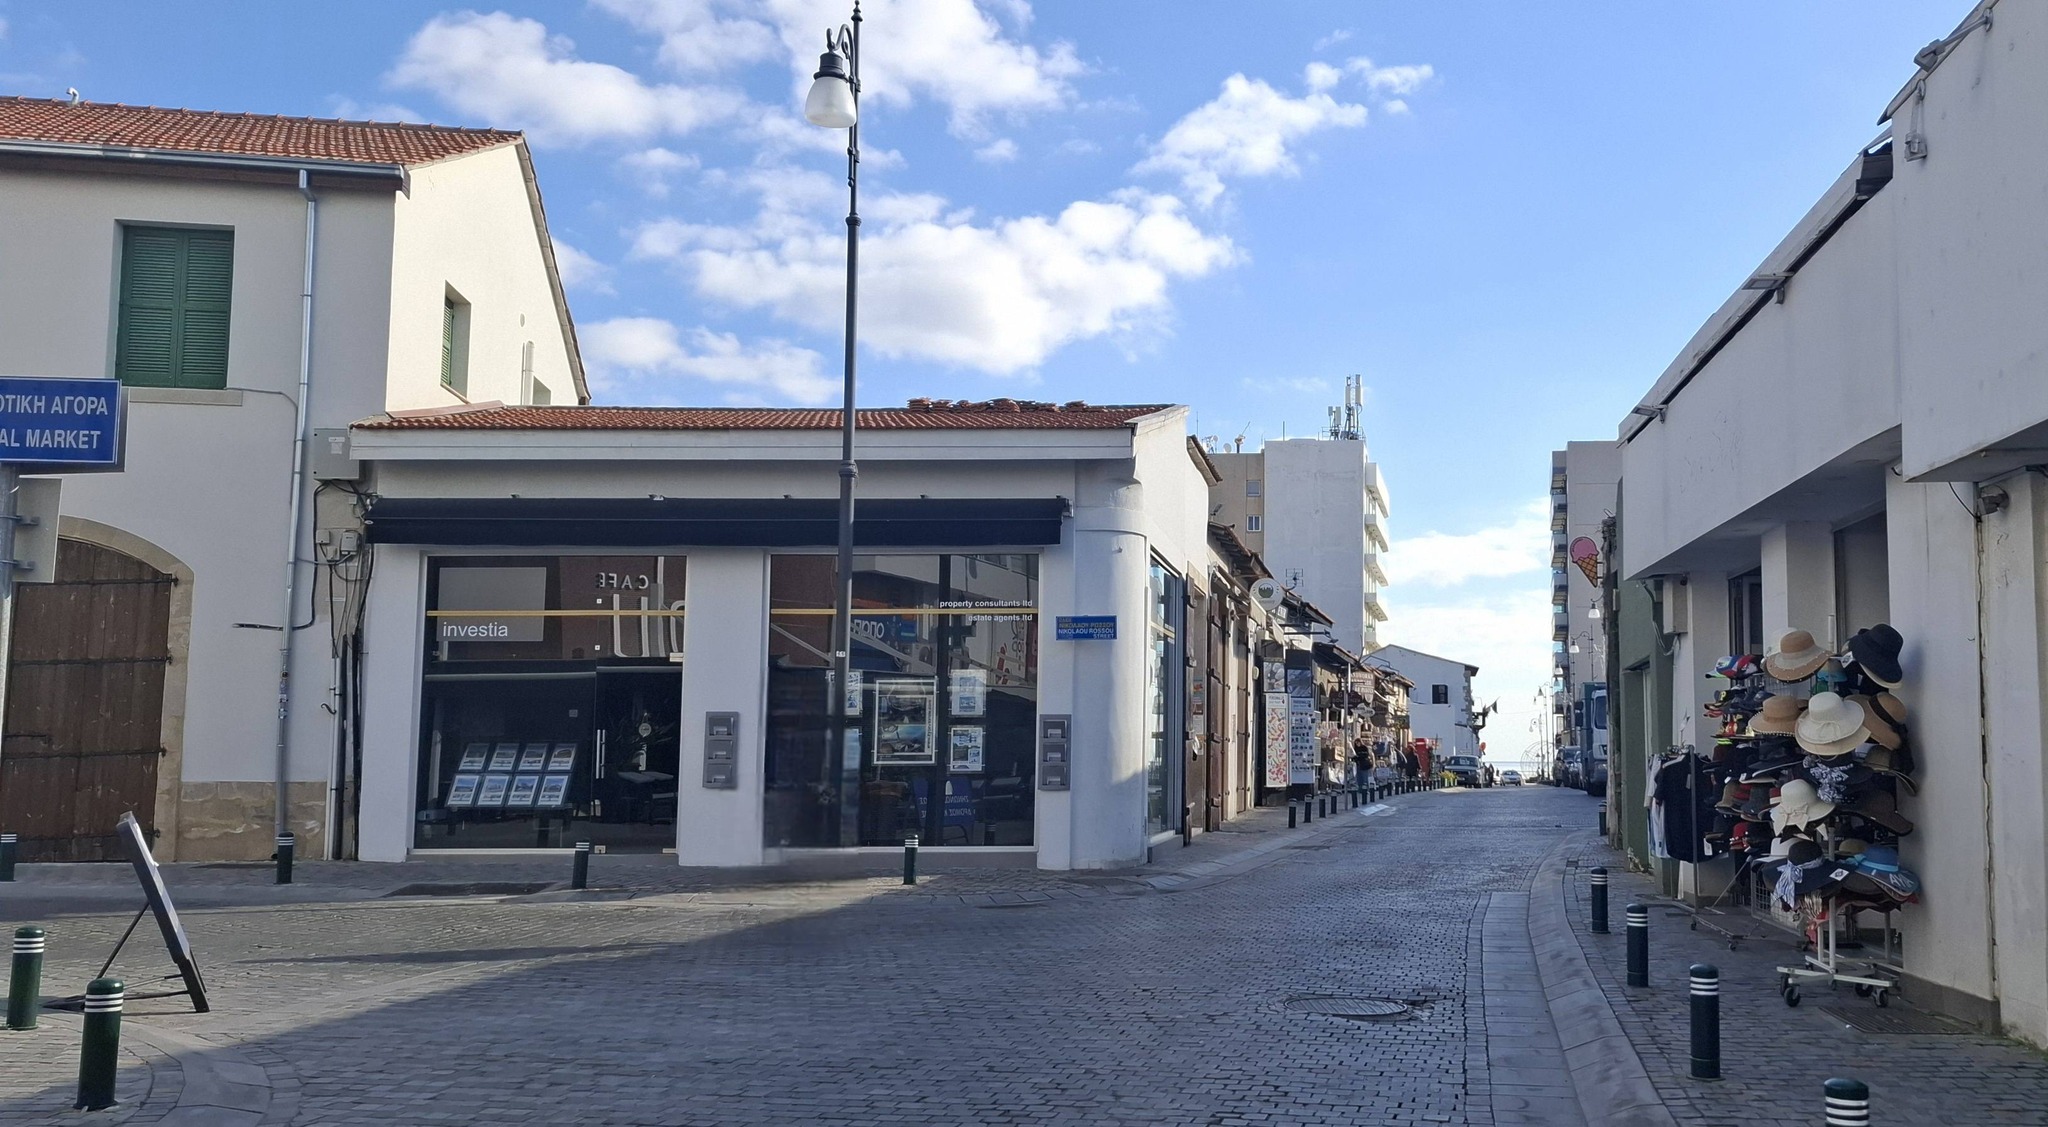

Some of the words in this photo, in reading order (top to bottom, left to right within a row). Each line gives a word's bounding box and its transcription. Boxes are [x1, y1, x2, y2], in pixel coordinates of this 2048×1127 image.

[51, 396, 108, 415] ΑΓΟΡΑ
[26, 429, 101, 449] MARKET
[939, 600, 973, 608] property
[975, 599, 1020, 607] consultants
[994, 614, 1020, 622] agents
[443, 622, 508, 637] investia
